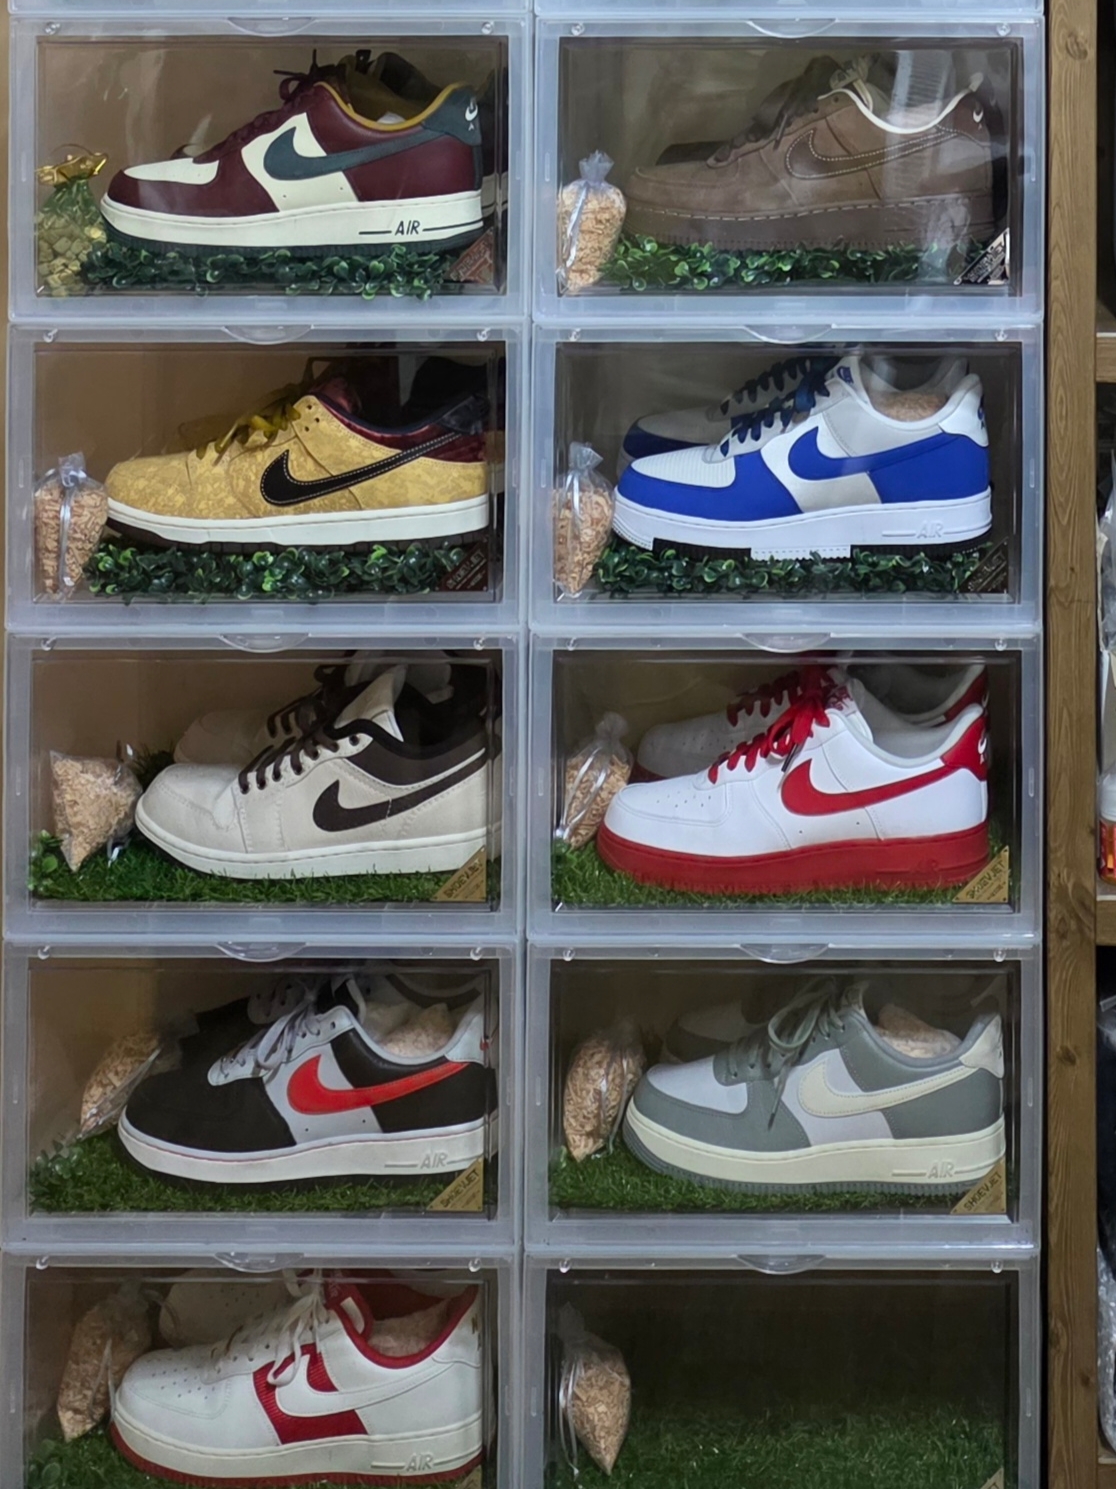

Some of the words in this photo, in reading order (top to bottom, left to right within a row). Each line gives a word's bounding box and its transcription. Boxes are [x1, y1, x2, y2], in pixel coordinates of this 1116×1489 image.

[394, 220, 421, 236] AIR
[917, 523, 944, 538] AIR
[420, 1152, 448, 1169] AIR
[928, 1163, 955, 1179] AIR
[440, 1167, 481, 1209] SHOEVJET
[962, 1170, 1003, 1211] SHOEVJET
[406, 1454, 434, 1472] AIR
